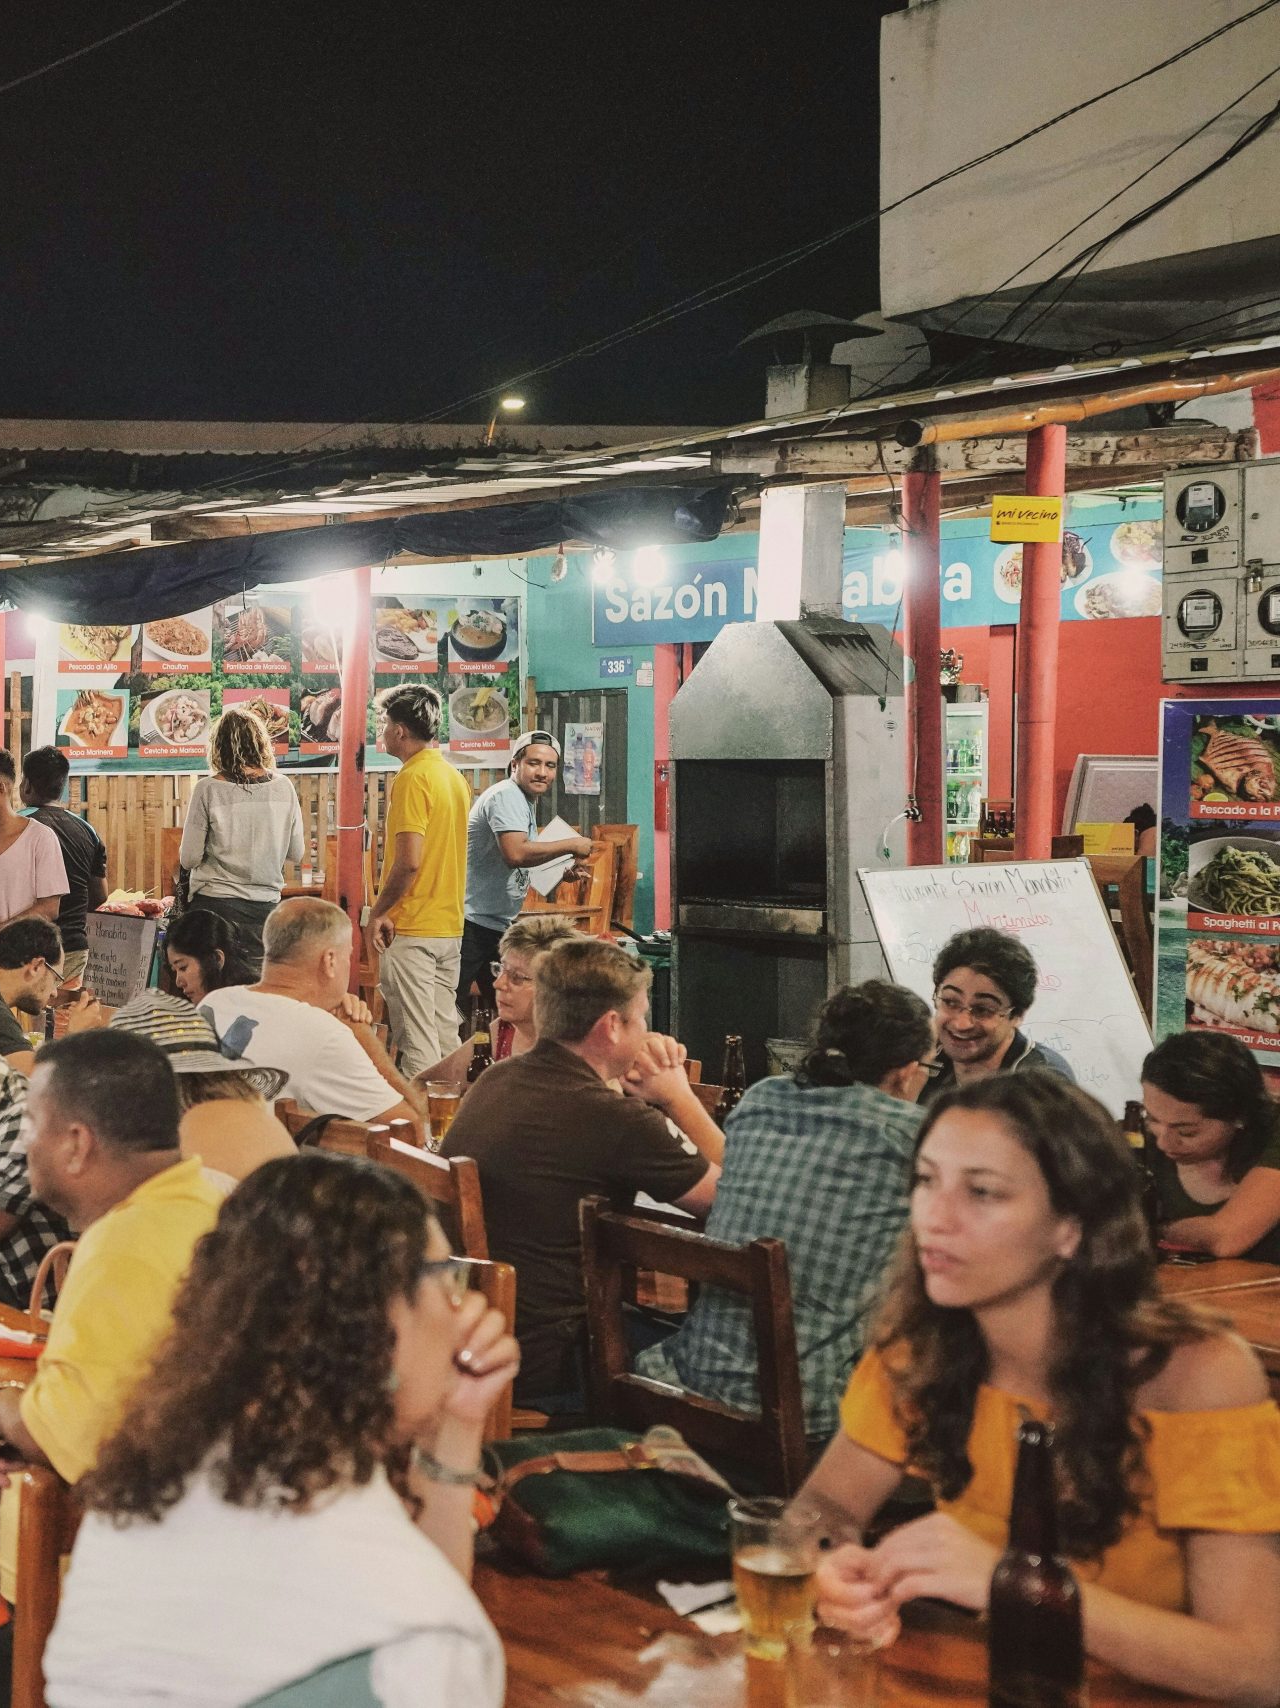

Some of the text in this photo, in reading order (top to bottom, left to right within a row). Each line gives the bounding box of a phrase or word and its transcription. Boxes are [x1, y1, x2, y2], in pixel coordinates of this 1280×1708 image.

[996, 508, 1058, 520] mi vecino
[605, 573, 727, 624] Sazón
[68, 663, 95, 671] Pescado
[95, 663, 103, 671] al
[253, 663, 262, 671] de
[262, 663, 287, 671] Mariscos
[607, 660, 625, 674] 336
[68, 747, 114, 758] Sopa Marinera
[143, 746, 205, 755] Ceviche de Mariscos
[1199, 804, 1246, 815] Pescado
[1248, 806, 1257, 815] a
[1260, 804, 1271, 816] la
[1203, 917, 1256, 930] Spaghetti
[1258, 919, 1270, 931] al
